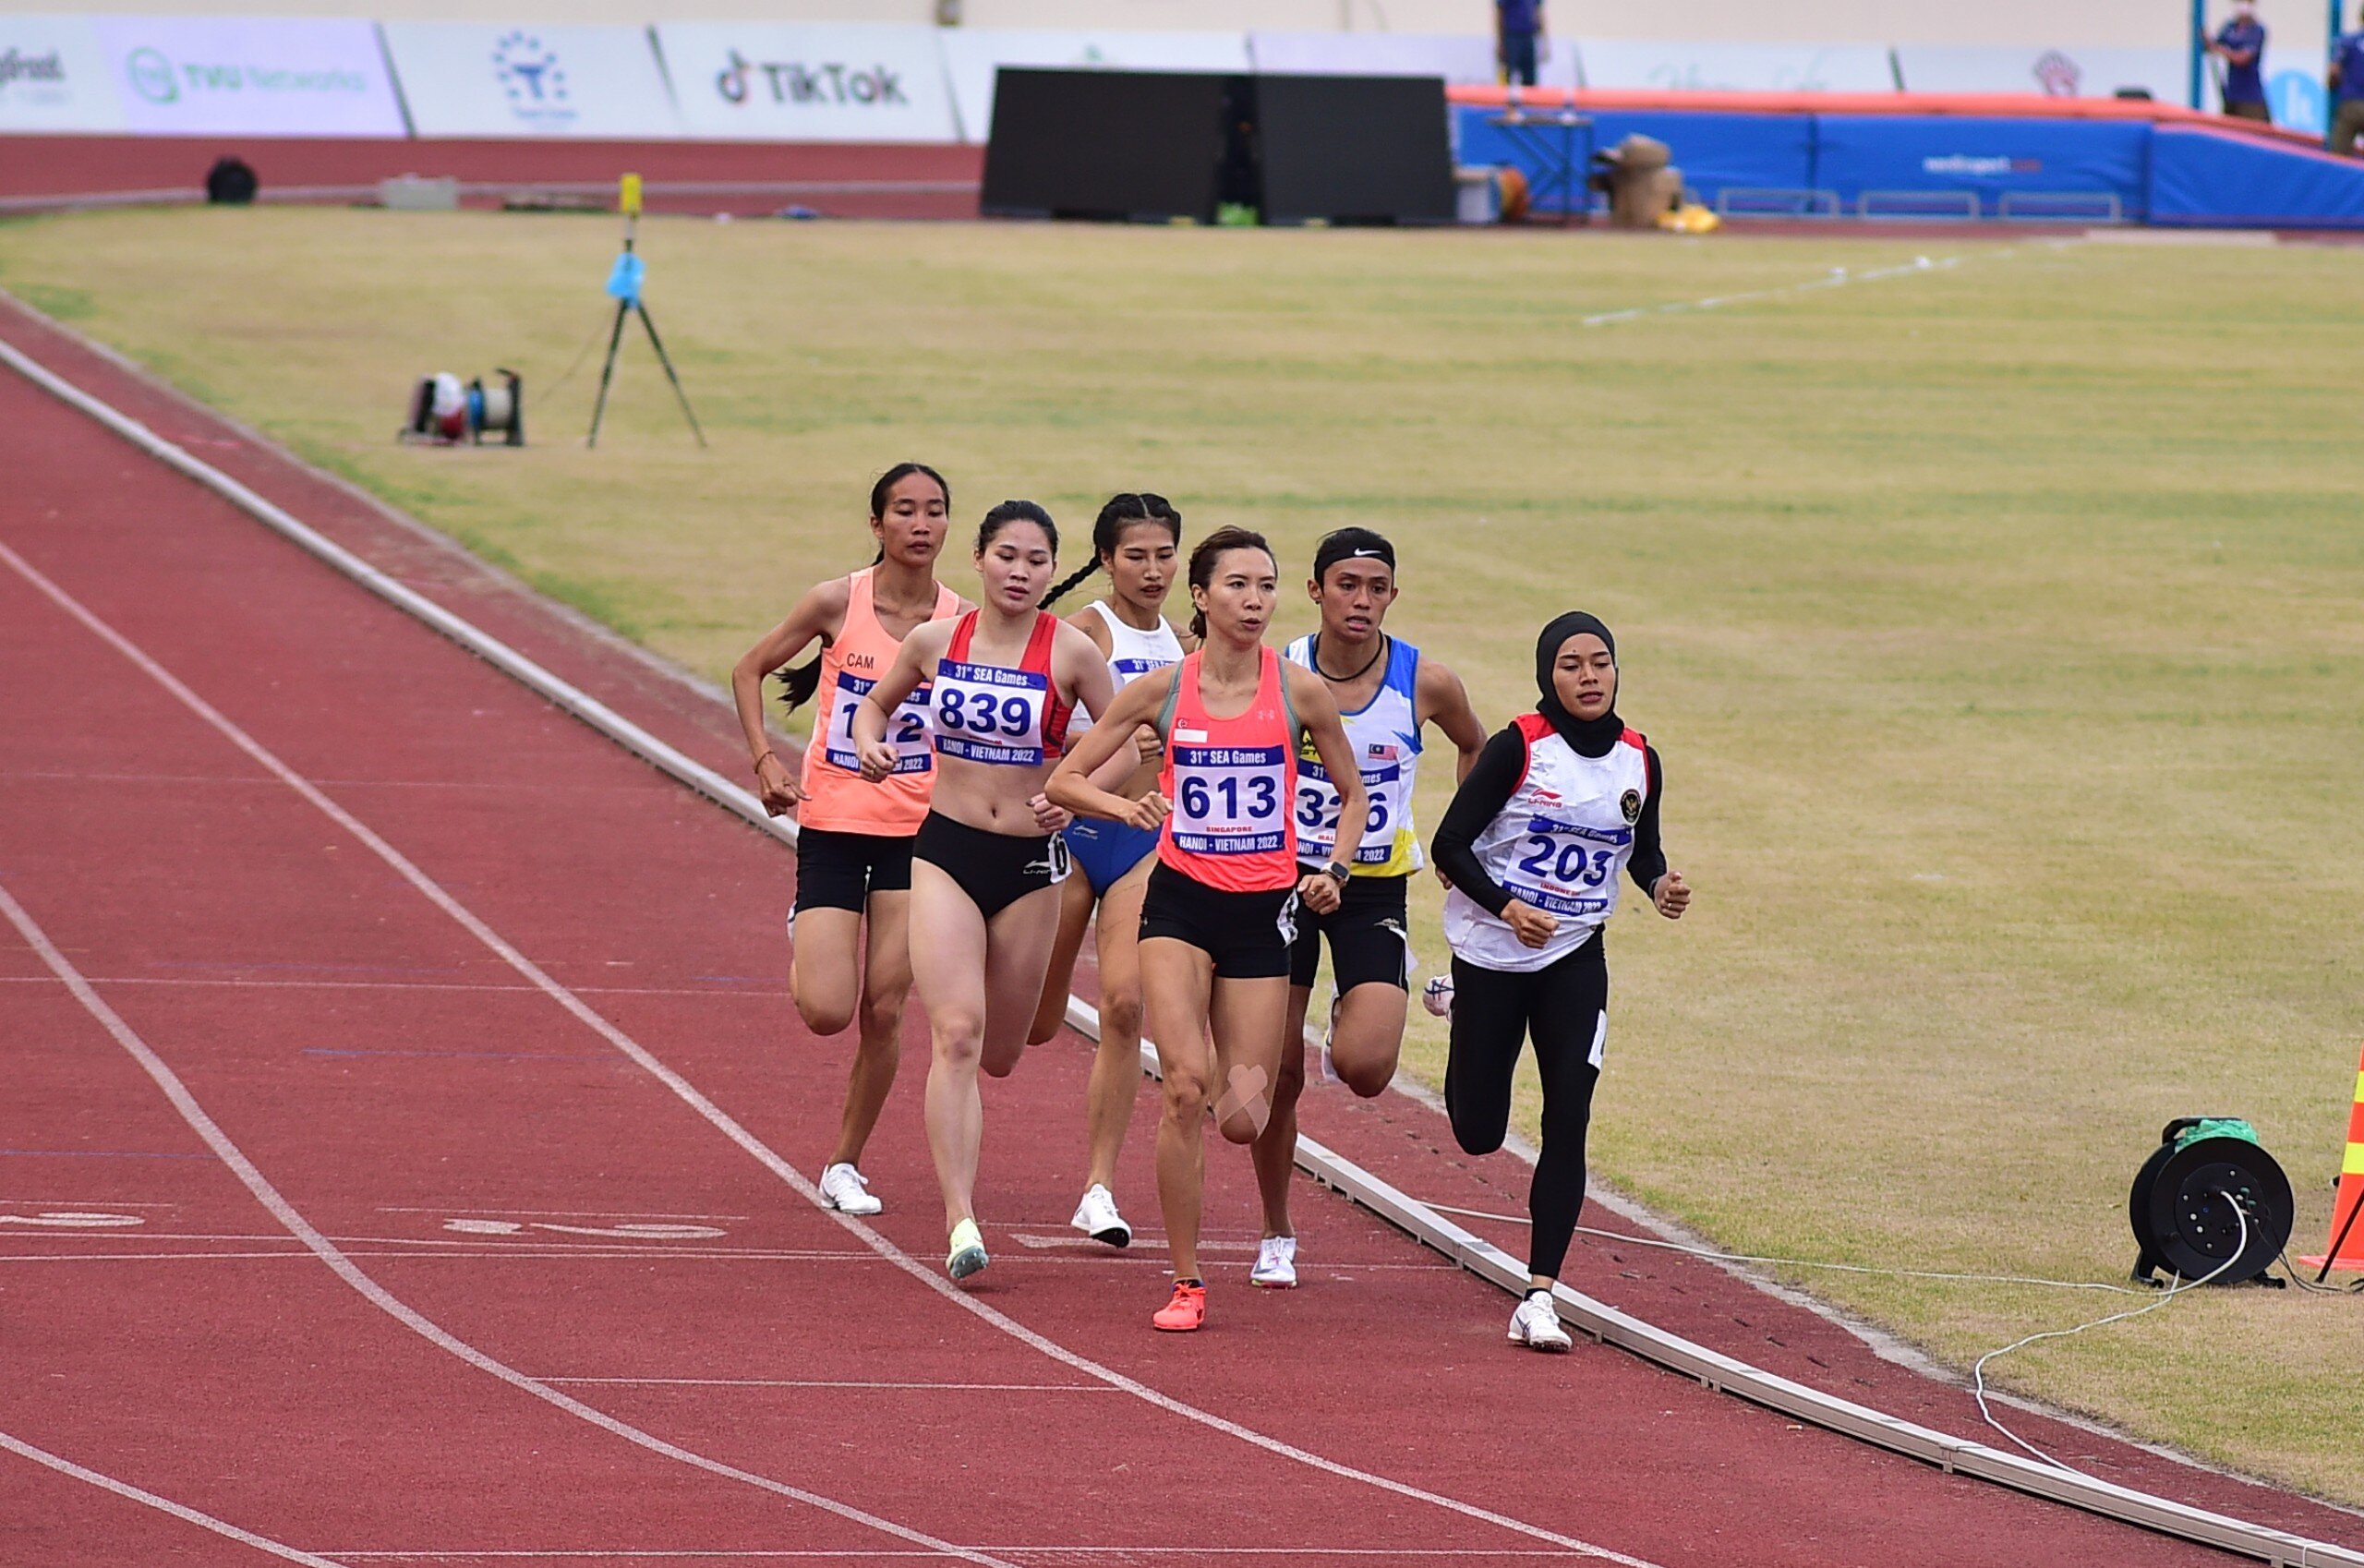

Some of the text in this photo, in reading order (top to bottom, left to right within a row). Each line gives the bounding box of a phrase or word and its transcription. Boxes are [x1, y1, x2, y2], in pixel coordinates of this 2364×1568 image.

[183, 62, 243, 90] TVU
[759, 61, 911, 105] TikTok
[846, 652, 874, 669] CAM
[1132, 659, 1145, 671] 31
[972, 667, 993, 682] SEA
[994, 669, 1029, 686] Games
[852, 678, 871, 694] 31
[938, 687, 1031, 737] 839
[842, 702, 925, 743] 12
[832, 752, 860, 769] HANOI
[971, 744, 1011, 762] VIETNAM
[1010, 749, 1035, 763] 2022
[1209, 749, 1231, 765] SEA
[1231, 749, 1267, 765] Games
[902, 757, 924, 771] 2022
[1361, 773, 1382, 784] mes
[1181, 776, 1276, 820] 613
[1205, 826, 1253, 834] SINGAPORE
[1178, 835, 1209, 850] HANOI
[1214, 837, 1257, 852] VIETNAM
[1256, 834, 1279, 850] 2022
[1297, 840, 1315, 856] NOI
[1362, 849, 1385, 862] 2022
[1517, 834, 1616, 887] 203
